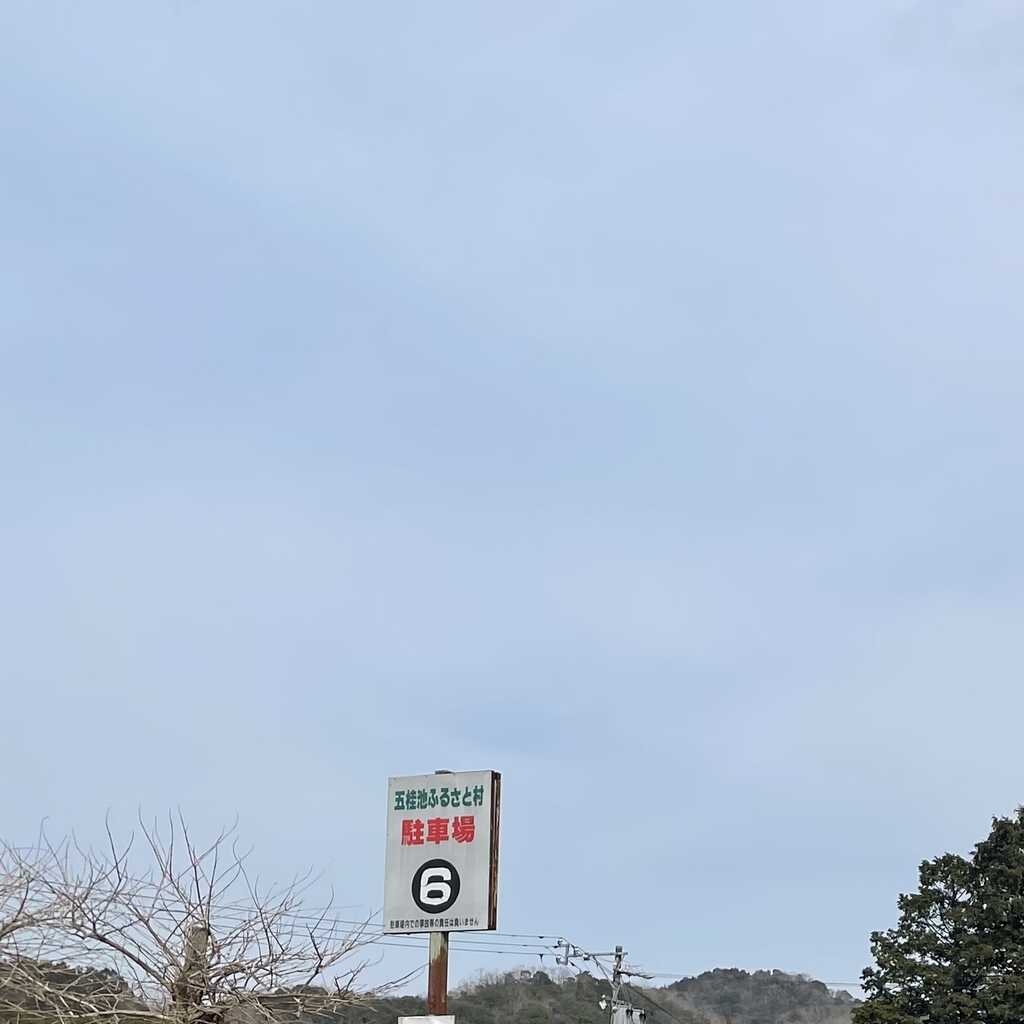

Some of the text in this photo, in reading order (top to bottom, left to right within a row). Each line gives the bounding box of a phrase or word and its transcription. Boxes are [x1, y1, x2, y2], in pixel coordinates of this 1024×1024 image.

[394, 785, 484, 811] 五桂池ふるさと村
[400, 815, 476, 846] 駐車場
[418, 866, 453, 907] 6
